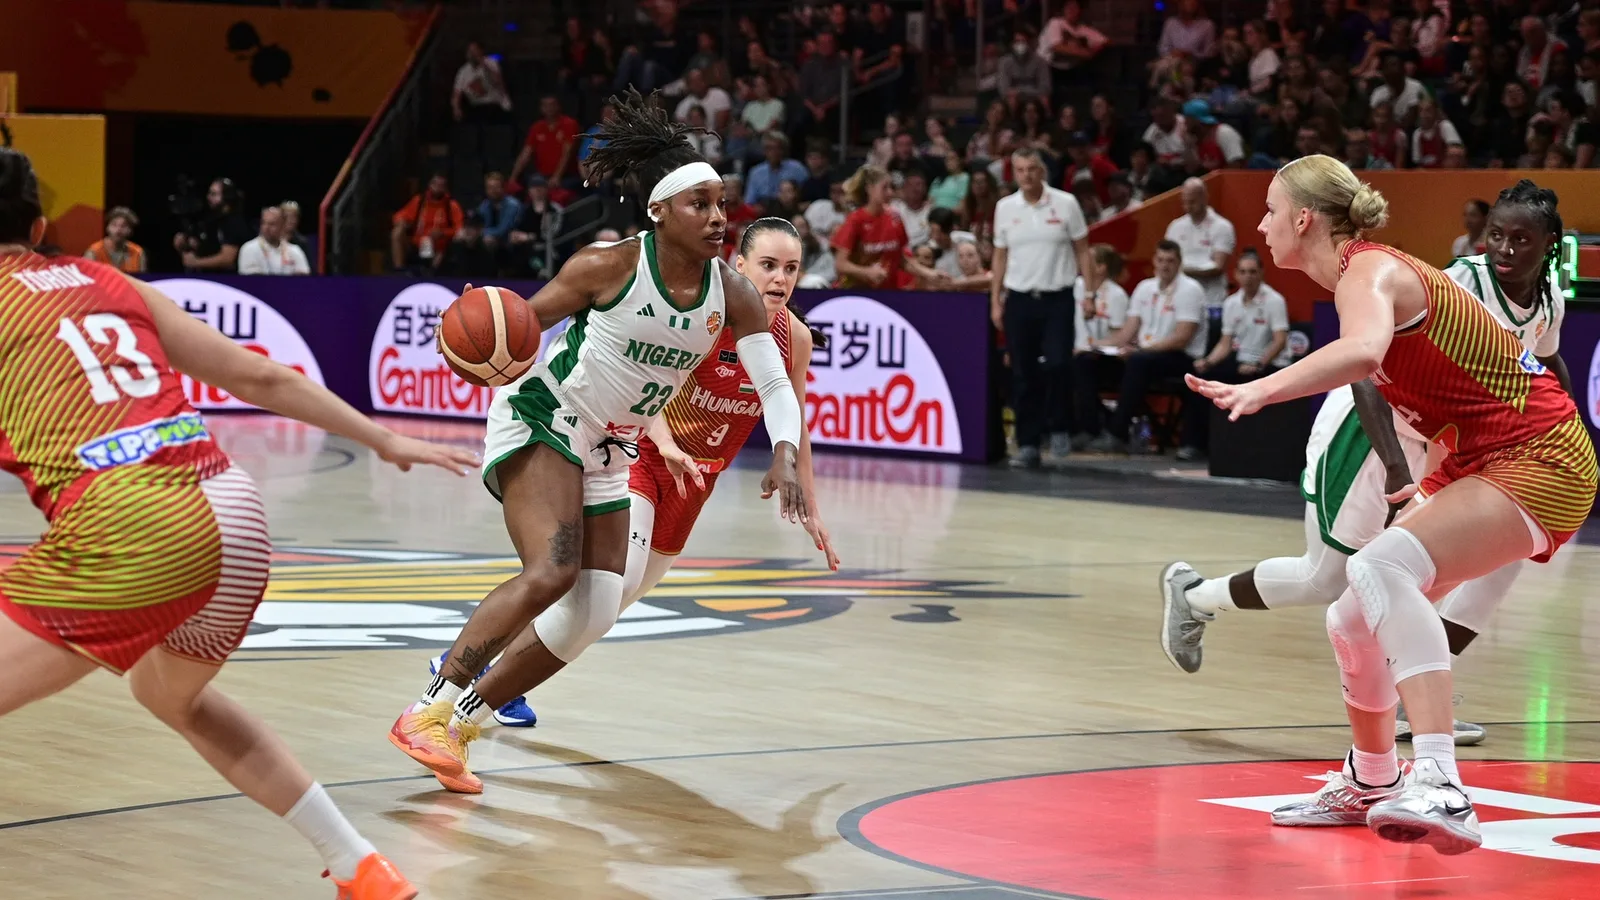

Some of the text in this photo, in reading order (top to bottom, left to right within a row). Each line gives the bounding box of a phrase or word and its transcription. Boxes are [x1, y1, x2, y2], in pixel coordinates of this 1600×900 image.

[394, 304, 440, 346] 百岁
[57, 313, 161, 405] 13
[623, 338, 706, 371] NIGERI
[629, 382, 674, 417] 23
[706, 423, 730, 447] 9
